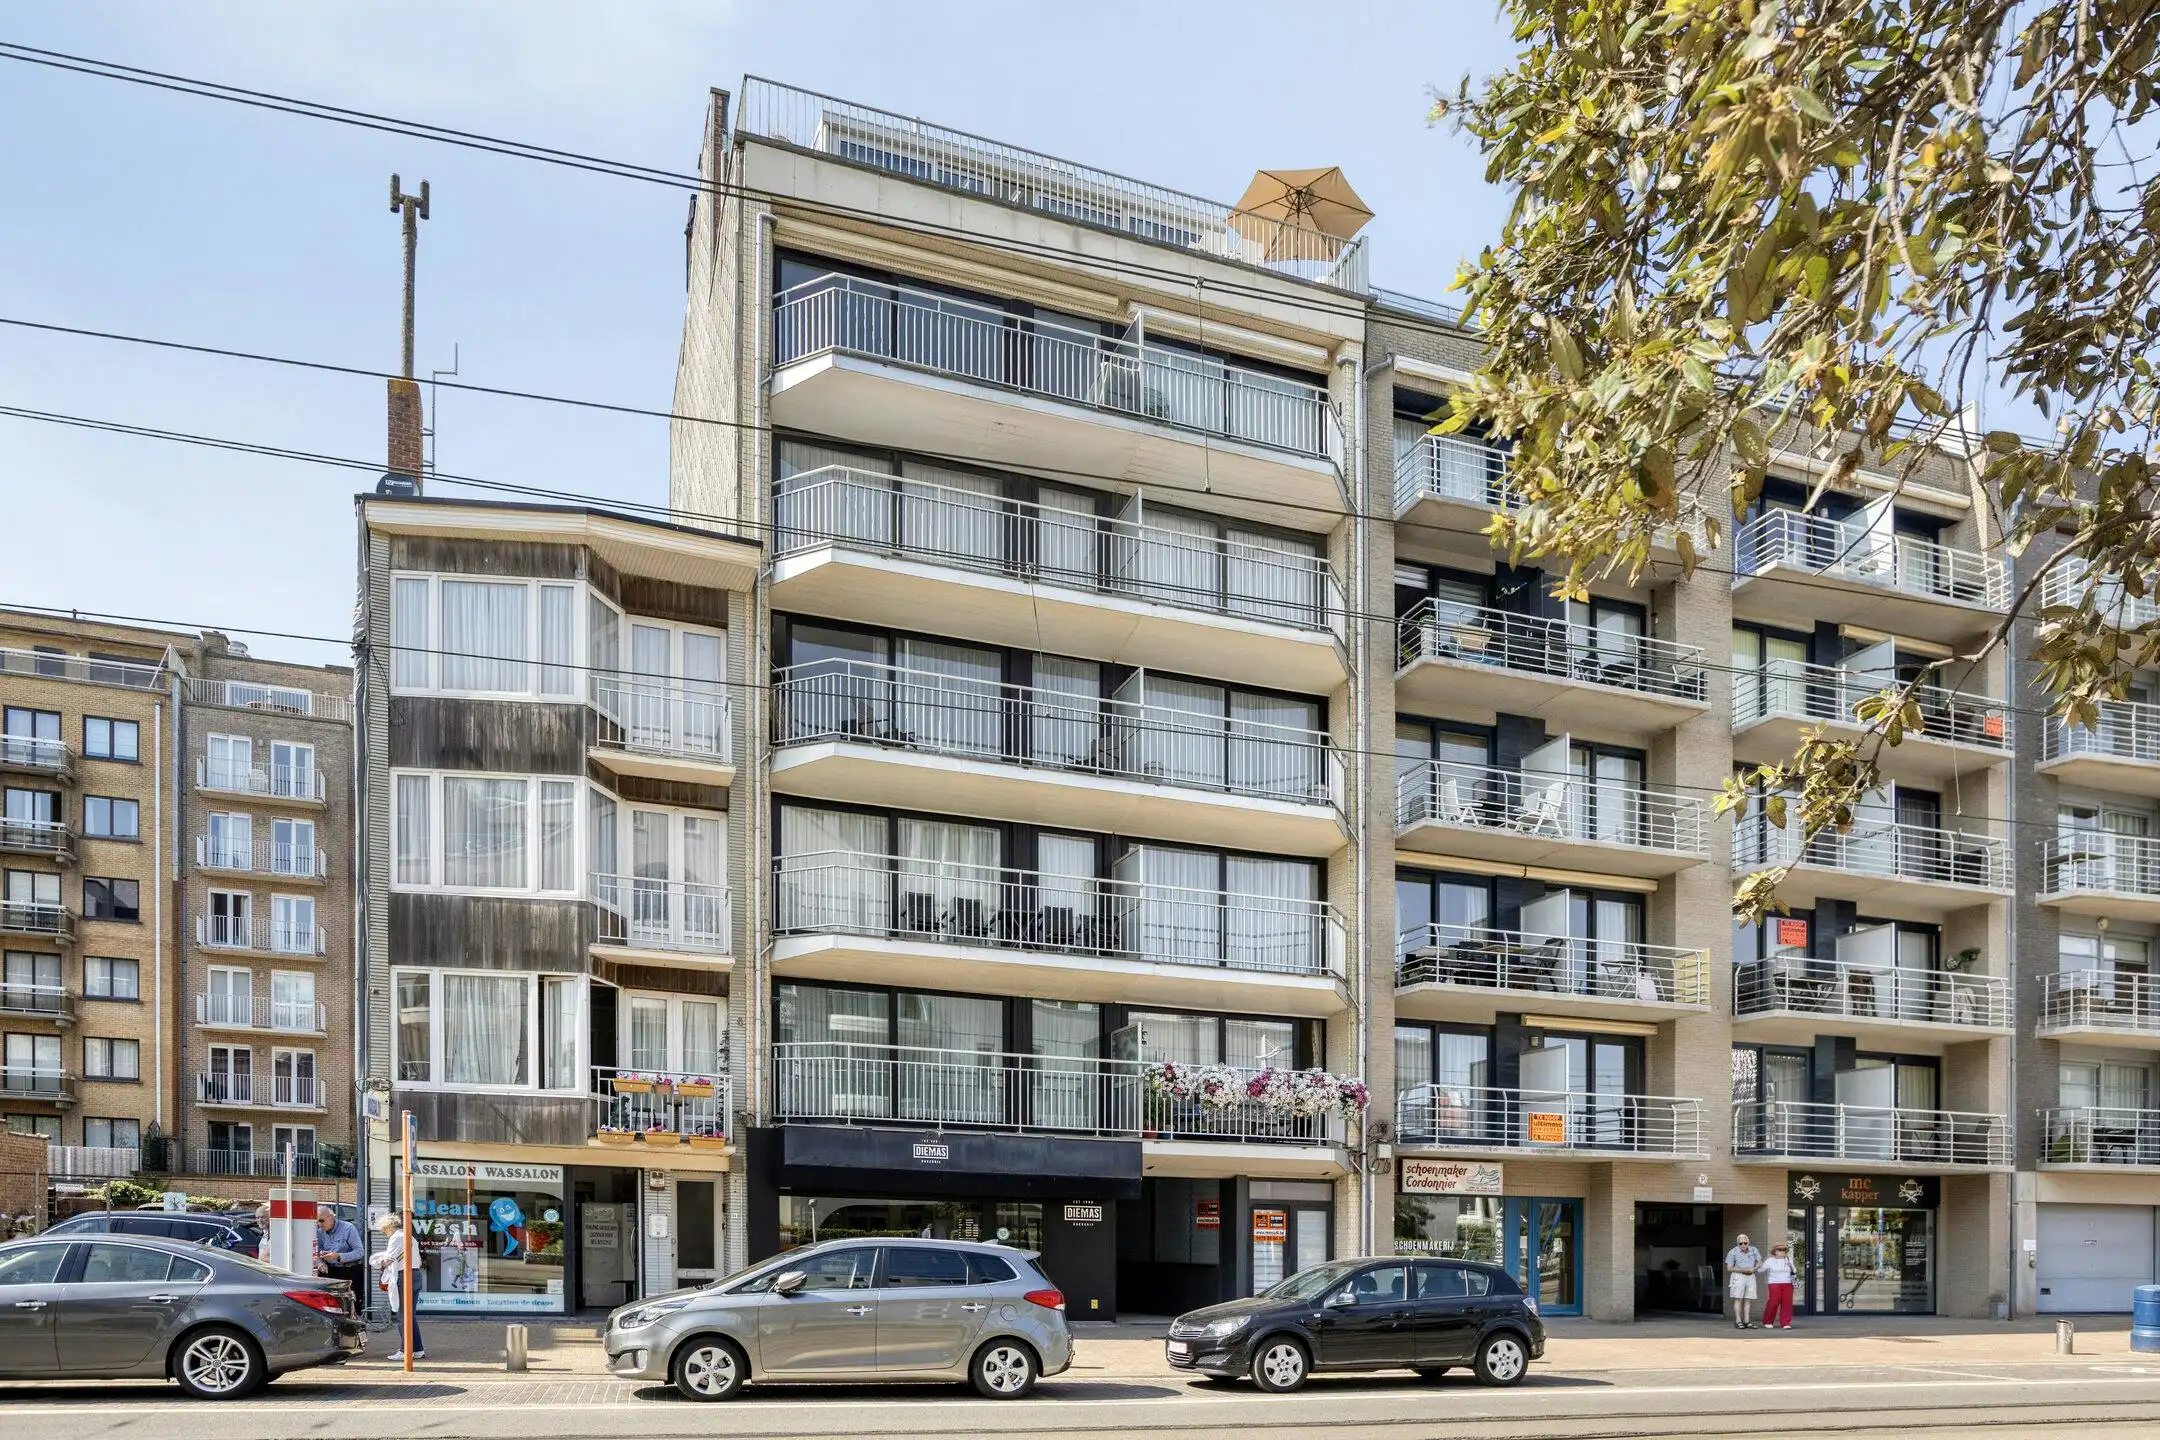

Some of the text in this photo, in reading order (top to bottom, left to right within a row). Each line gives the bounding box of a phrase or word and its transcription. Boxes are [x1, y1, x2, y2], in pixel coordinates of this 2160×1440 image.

[915, 1146, 947, 1157] DIEMAS
[401, 1163, 560, 1179] ASSALON WASSALON
[1406, 1163, 1468, 1177] schoenmaker
[1406, 1176, 1457, 1190] Cordonnier
[1841, 1188, 1880, 1202] kapper
[415, 1200, 478, 1216] Clean
[1067, 1207, 1100, 1219] DIEMAS
[413, 1219, 478, 1236] Wash
[1394, 1241, 1455, 1251] SCHOENMAKERIJ
